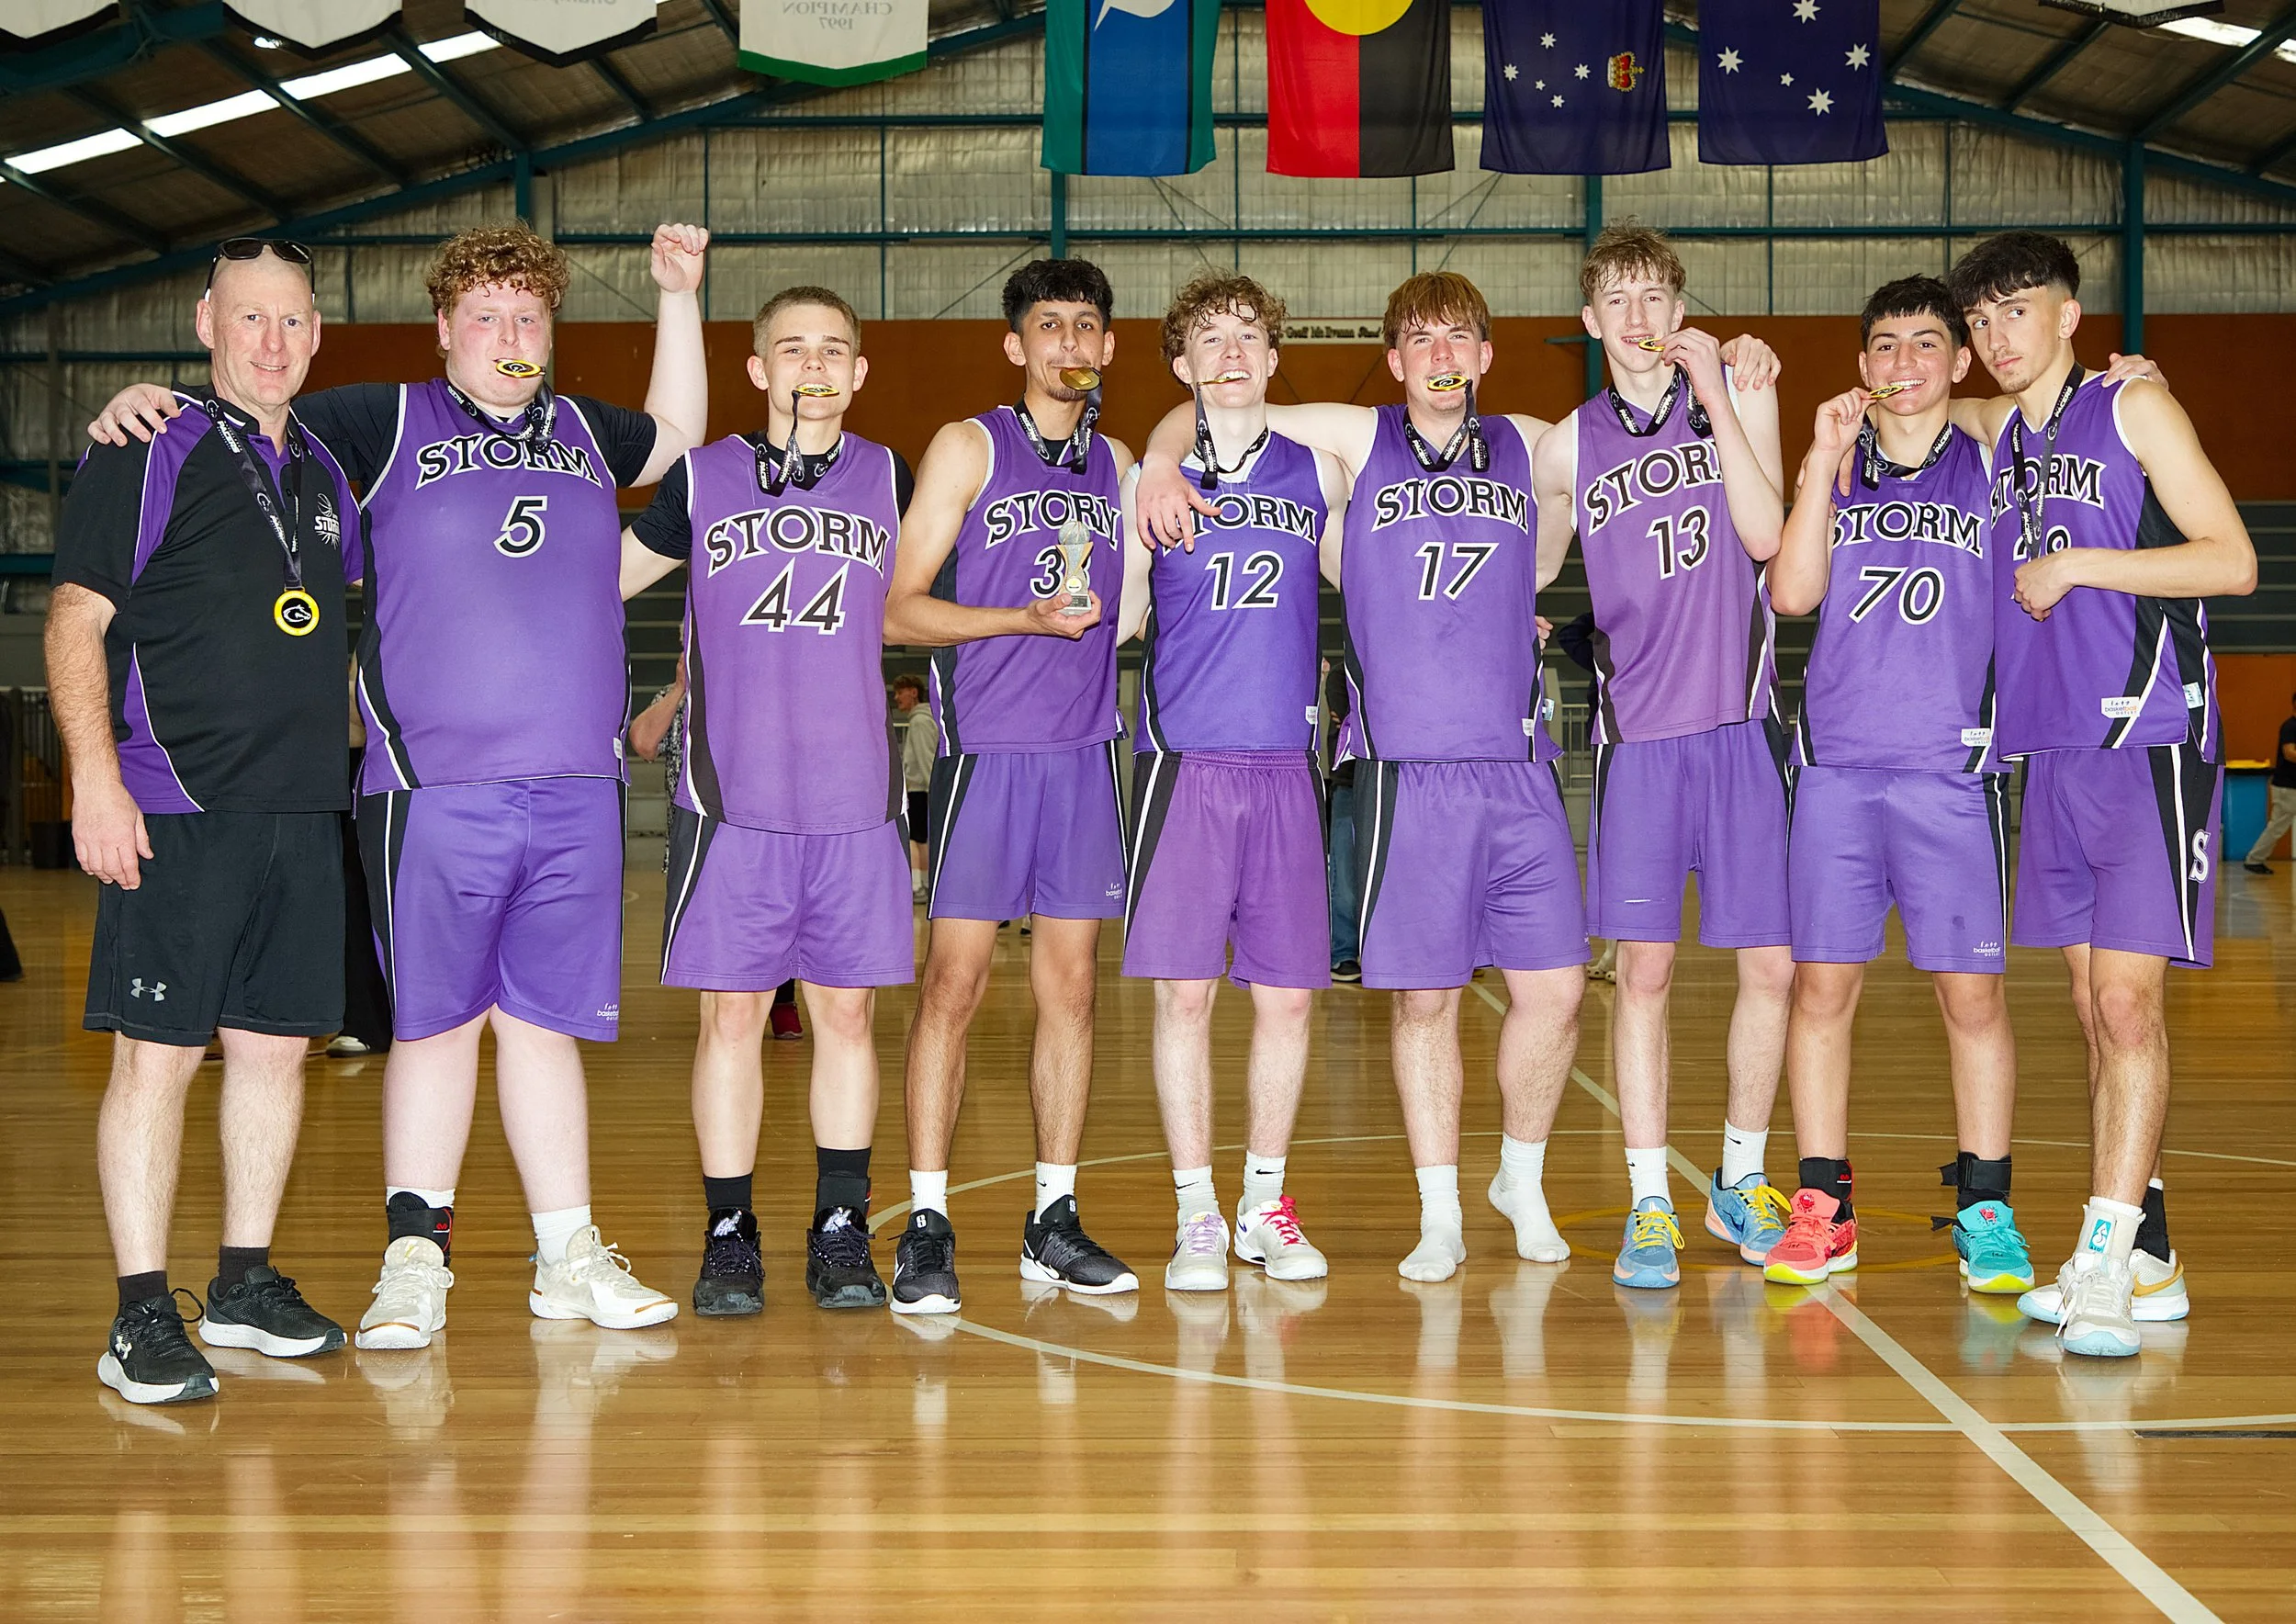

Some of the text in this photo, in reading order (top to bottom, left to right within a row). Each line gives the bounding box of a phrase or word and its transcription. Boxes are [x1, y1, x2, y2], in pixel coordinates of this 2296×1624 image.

[415, 433, 603, 491] STORM
[1583, 438, 1724, 536] STOR
[1990, 453, 2108, 531] STORM
[493, 495, 548, 558] 5
[984, 489, 1122, 551] STORM
[1164, 492, 1318, 557] TORM
[1370, 476, 1529, 536] STORM
[703, 504, 892, 580] STORM
[1030, 546, 1092, 599] 3
[1414, 541, 1500, 601] 17
[1645, 505, 1711, 581] 13
[738, 556, 850, 636] 44
[1205, 550, 1284, 611] 12
[1849, 566, 1945, 626] 70
[2188, 829, 2212, 884] S
